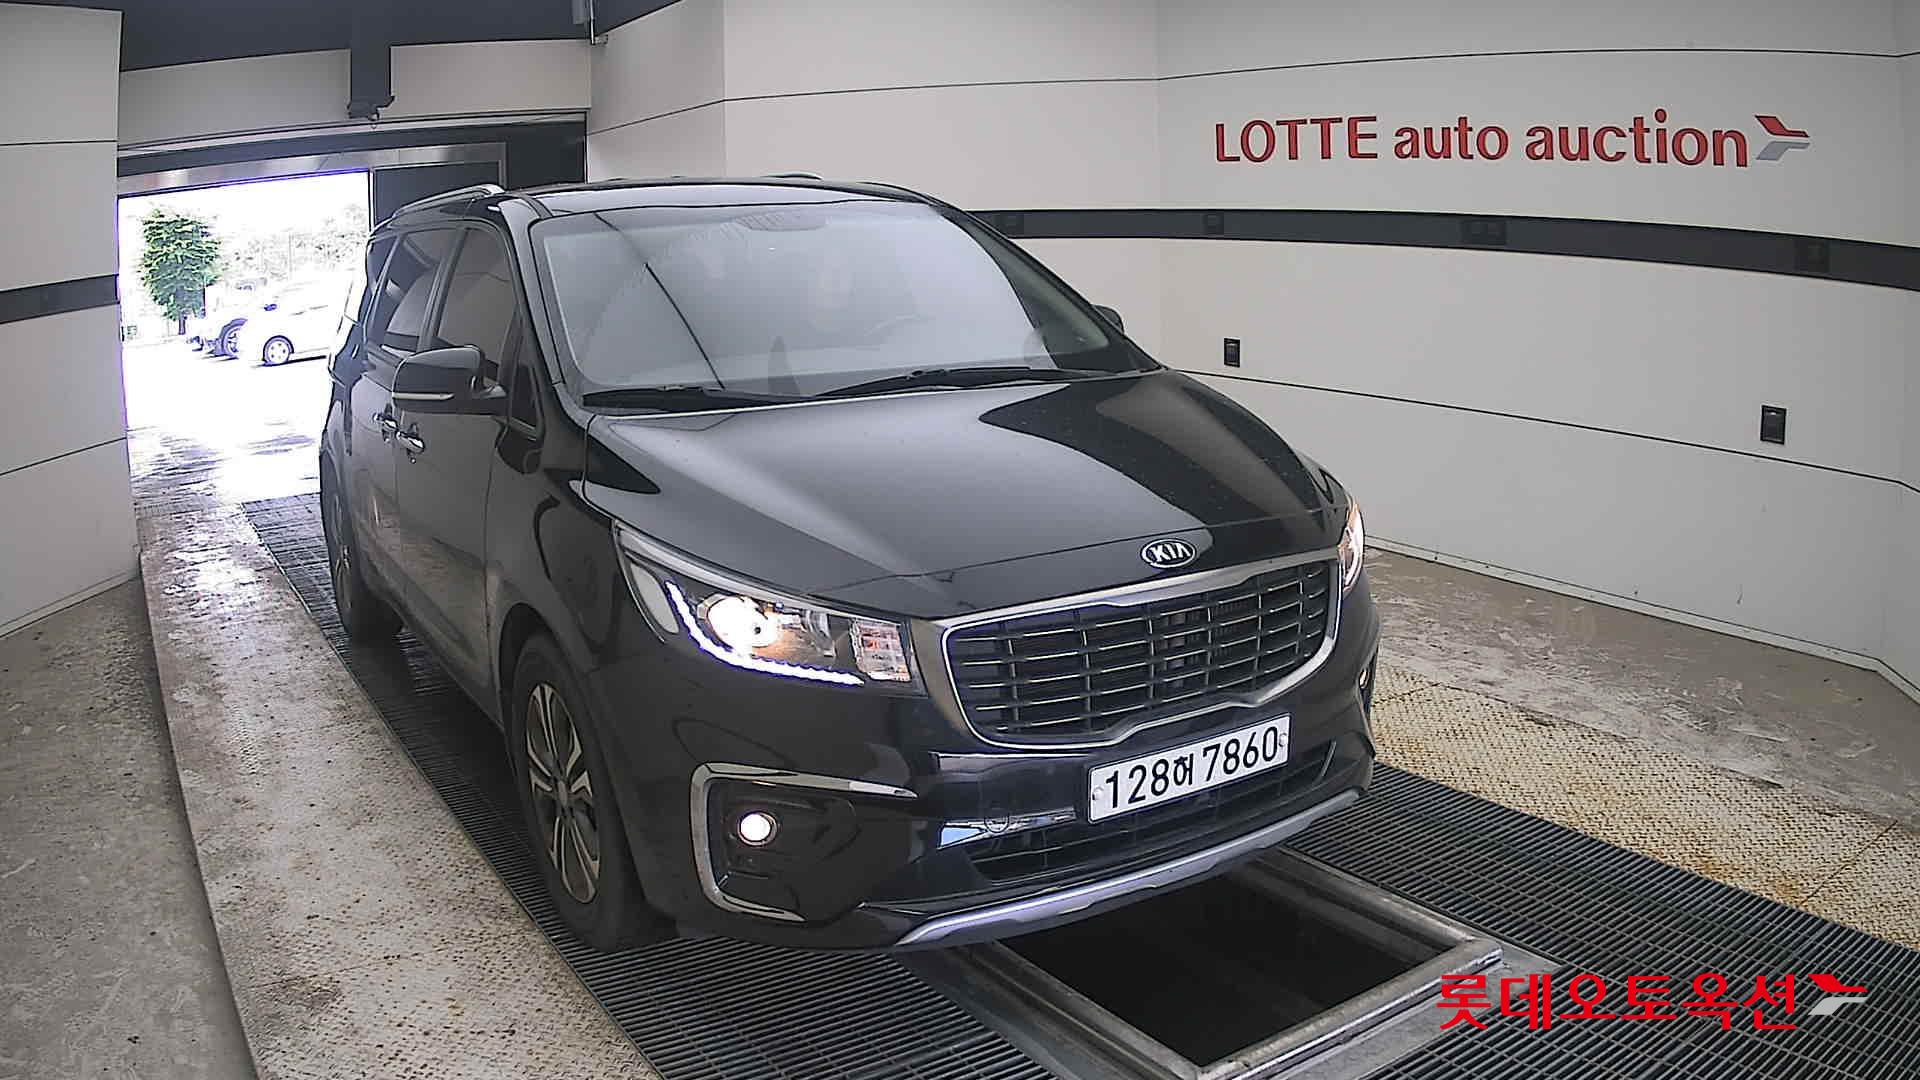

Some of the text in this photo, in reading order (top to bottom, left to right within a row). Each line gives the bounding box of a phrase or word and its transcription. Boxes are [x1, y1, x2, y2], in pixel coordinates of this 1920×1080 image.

[1215, 108, 1749, 168] LOTTE auto auction
[1148, 541, 1192, 562] KIA
[1105, 726, 1279, 809] 128허 7860
